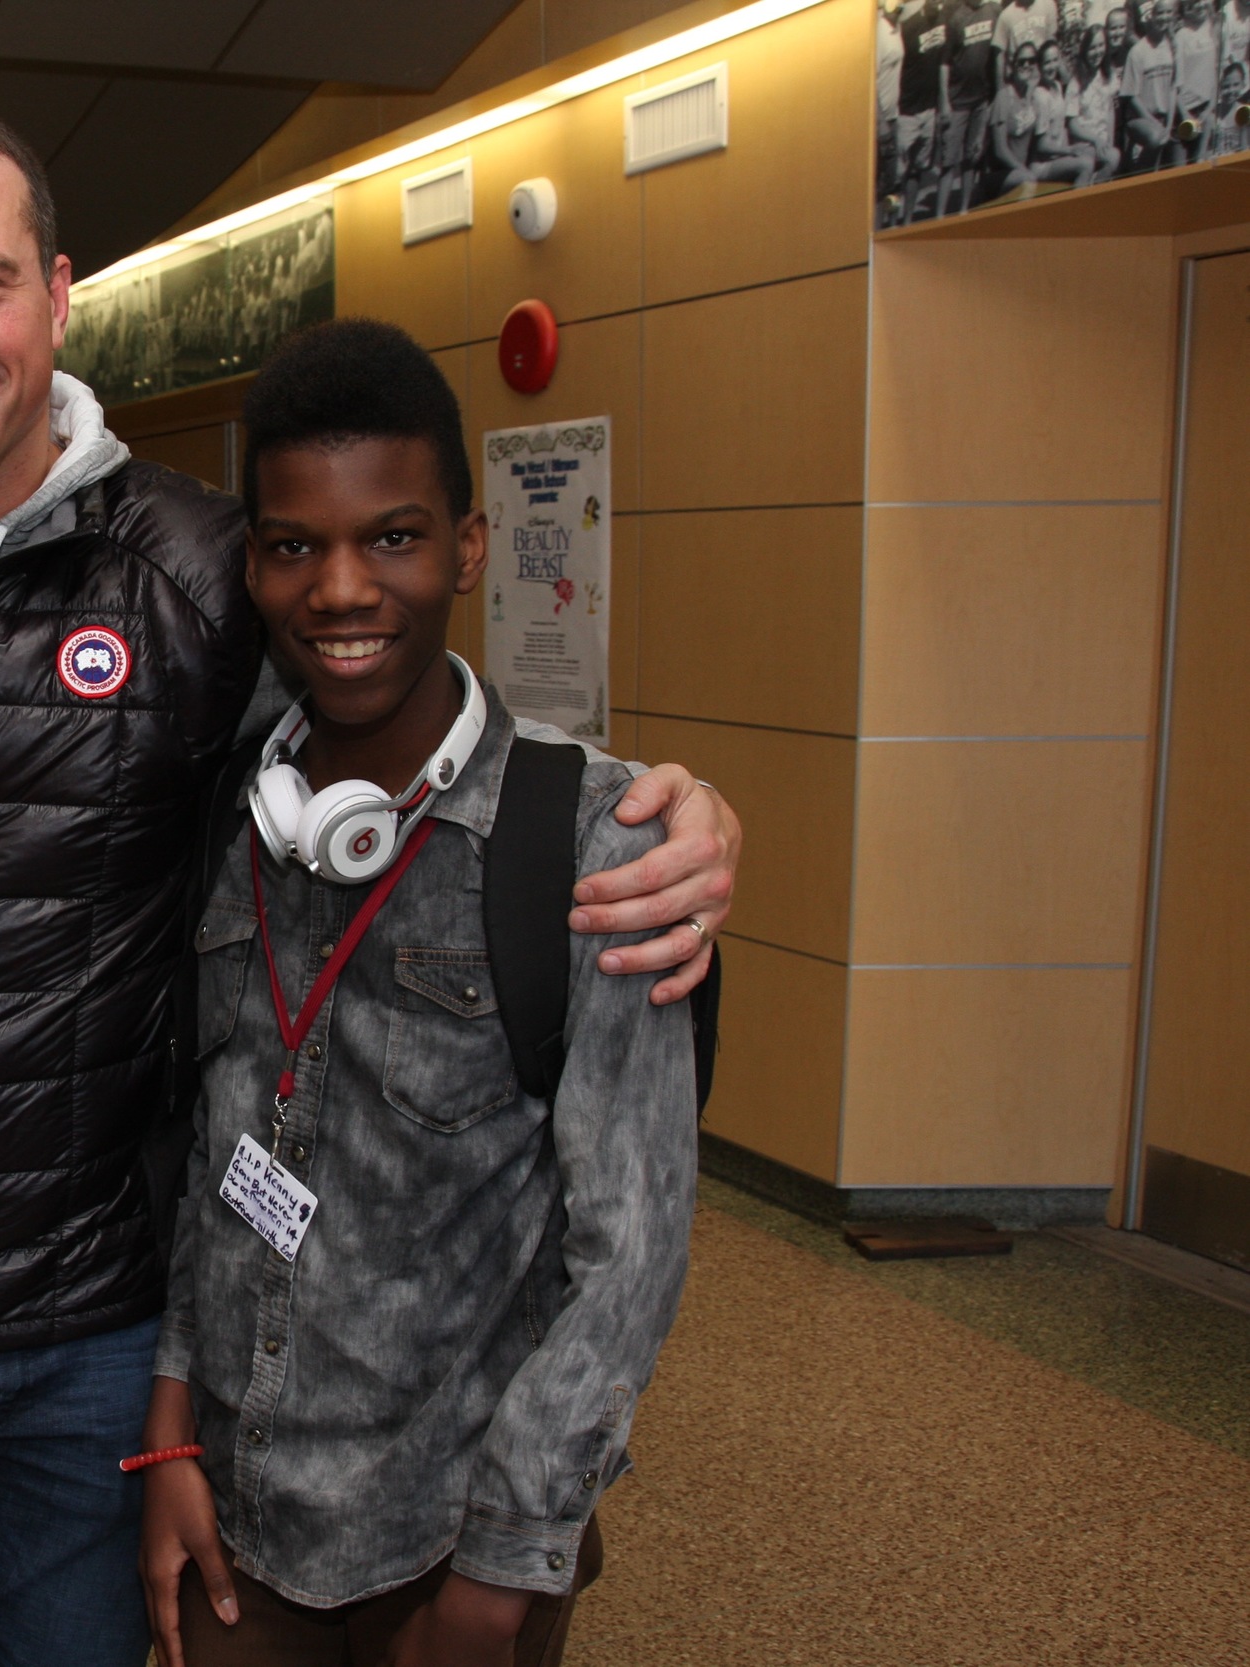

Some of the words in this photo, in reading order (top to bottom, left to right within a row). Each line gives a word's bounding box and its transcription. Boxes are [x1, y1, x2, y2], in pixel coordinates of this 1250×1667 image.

[513, 526, 573, 551] BEAUTY
[518, 553, 568, 578] BEAST
[71, 632, 97, 647] CANADA
[98, 633, 117, 647] GOOSE
[67, 672, 86, 690] ARCTIC
[86, 677, 117, 691] PROGRAM
[231, 1159, 251, 1183] Gone
[251, 1178, 268, 1198] But
[268, 1193, 293, 1221] Never
[263, 1166, 299, 1211] Kenny
[280, 1243, 295, 1260] End
